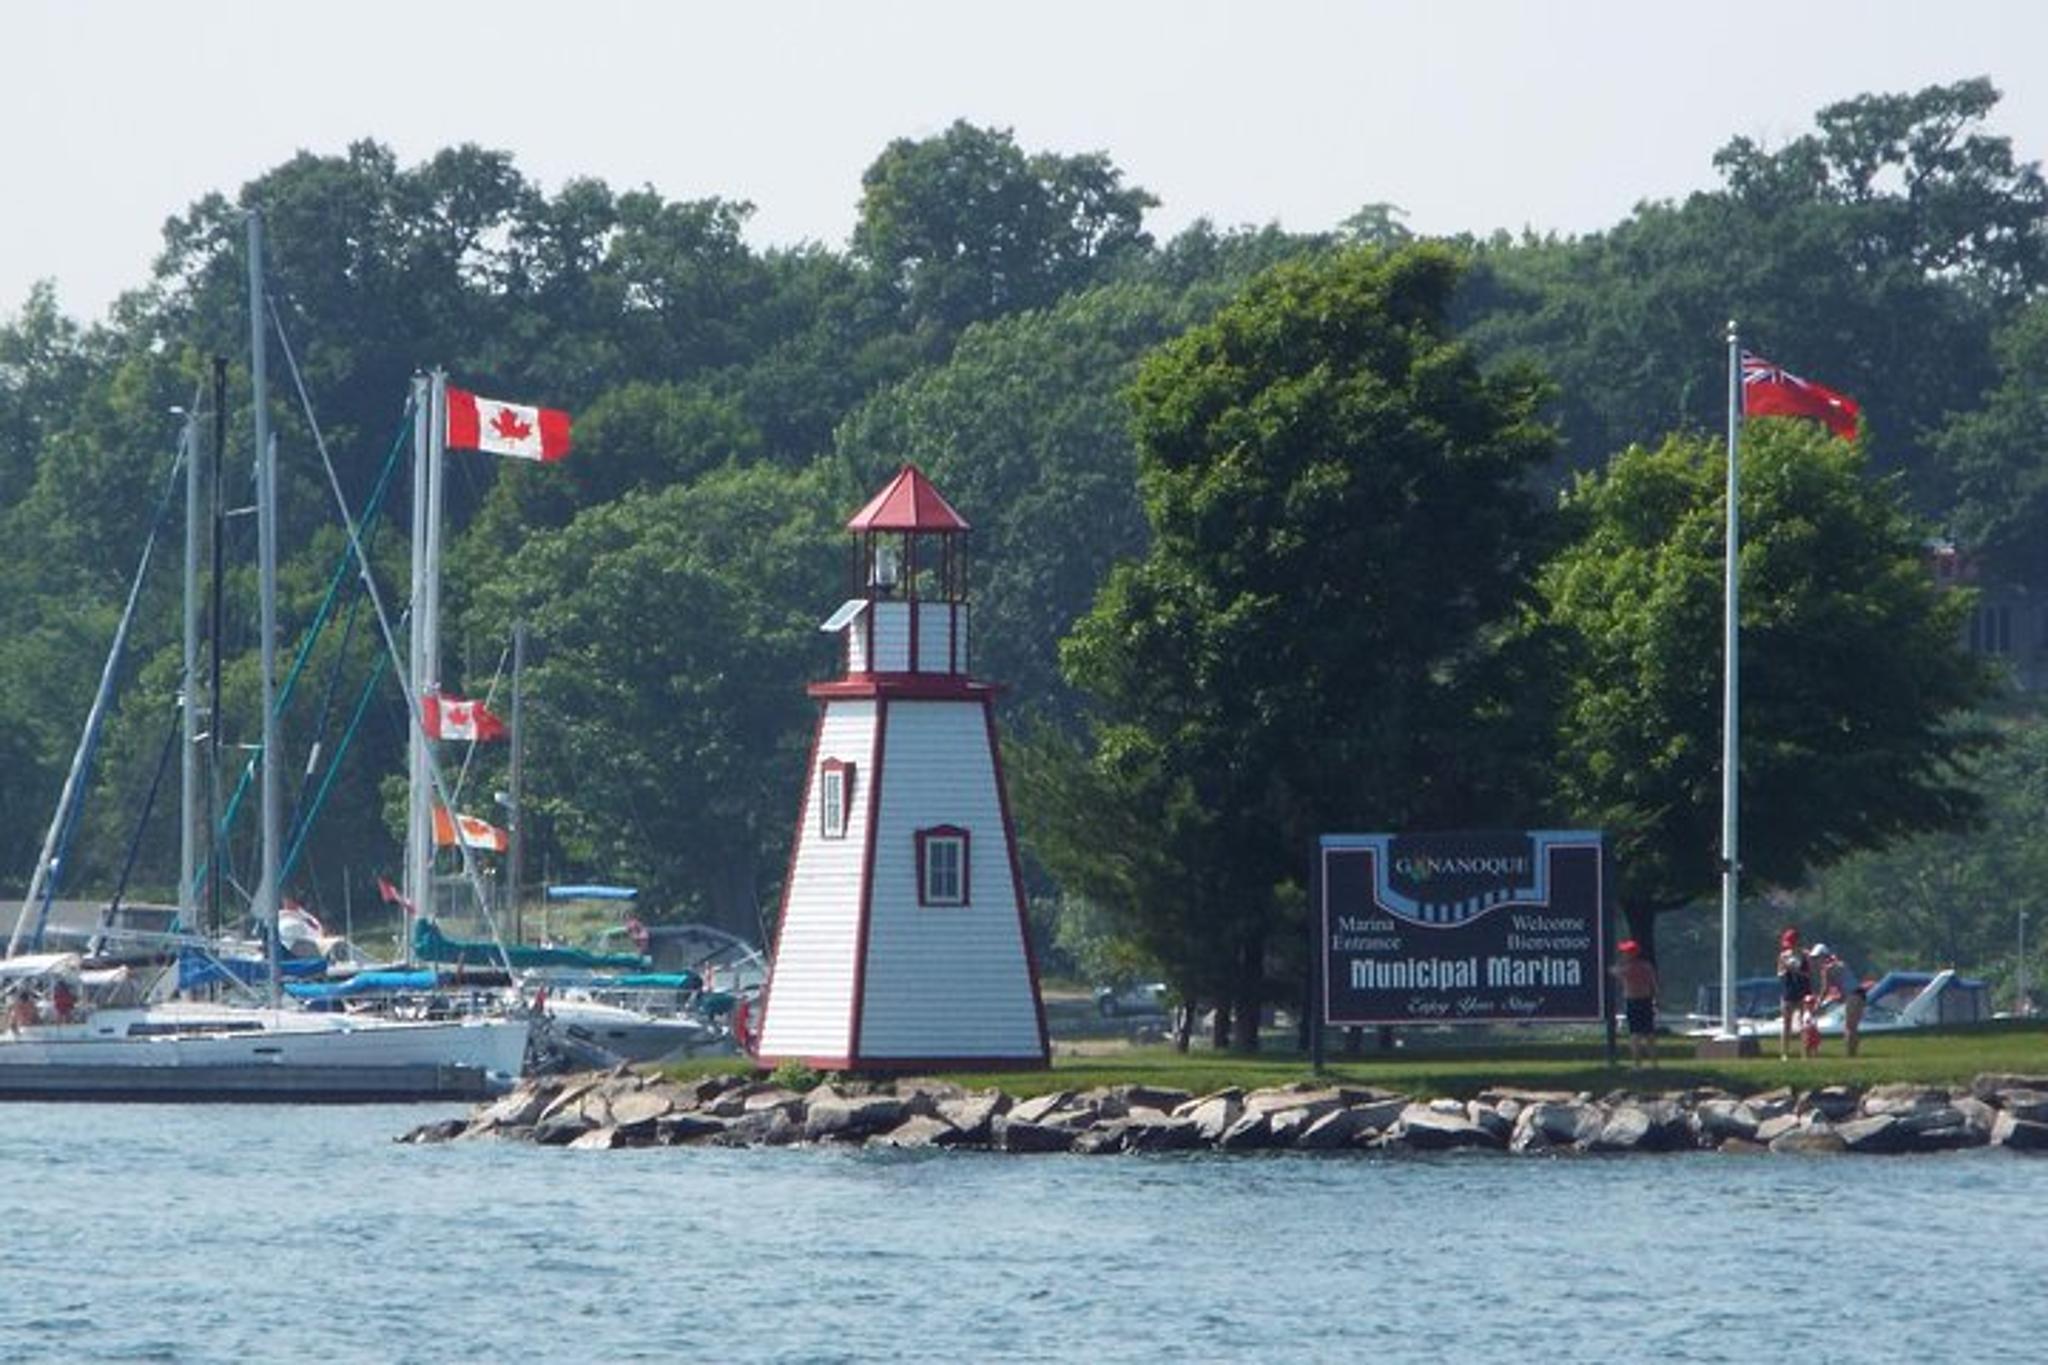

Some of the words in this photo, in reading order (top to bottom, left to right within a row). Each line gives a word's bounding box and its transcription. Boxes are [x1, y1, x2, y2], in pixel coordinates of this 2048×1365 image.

[1338, 916, 1395, 932] Marina
[1512, 915, 1585, 931] Welcome
[1333, 934, 1401, 951] Entrance
[1351, 957, 1477, 990] Municipal
[1487, 956, 1581, 987] Marina
